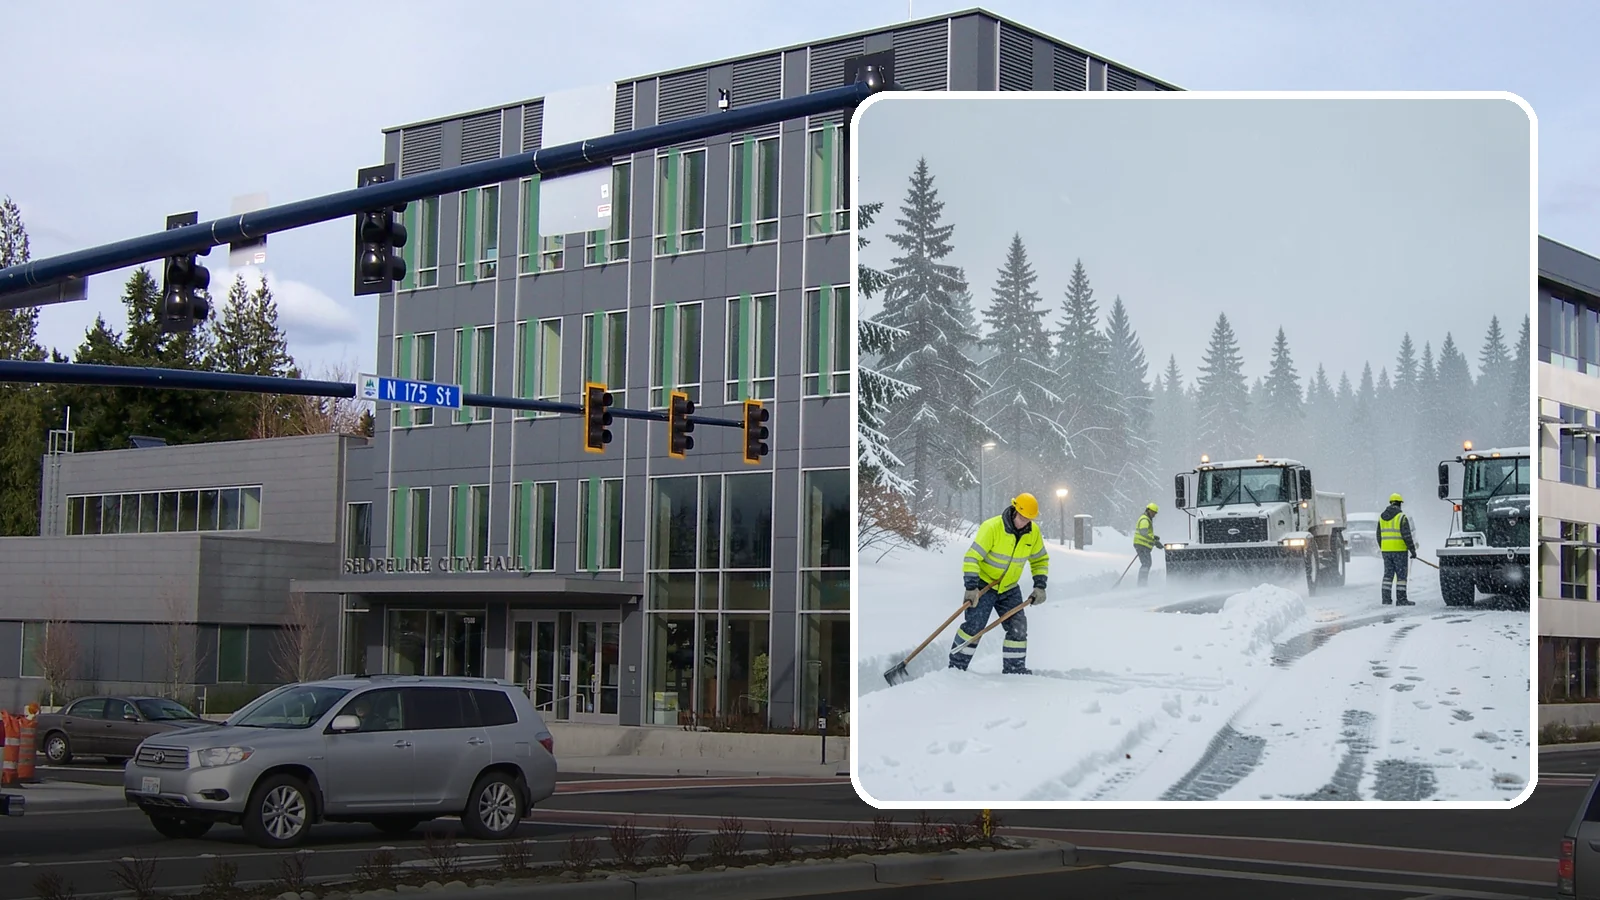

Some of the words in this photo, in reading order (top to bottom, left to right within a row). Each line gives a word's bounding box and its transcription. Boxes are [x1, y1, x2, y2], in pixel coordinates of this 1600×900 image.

[387, 380, 396, 400] N
[405, 382, 428, 403] 175
[436, 386, 451, 406] St
[344, 556, 432, 574] SHORELINE
[438, 556, 475, 572] CITY
[483, 556, 526, 571] HALL
